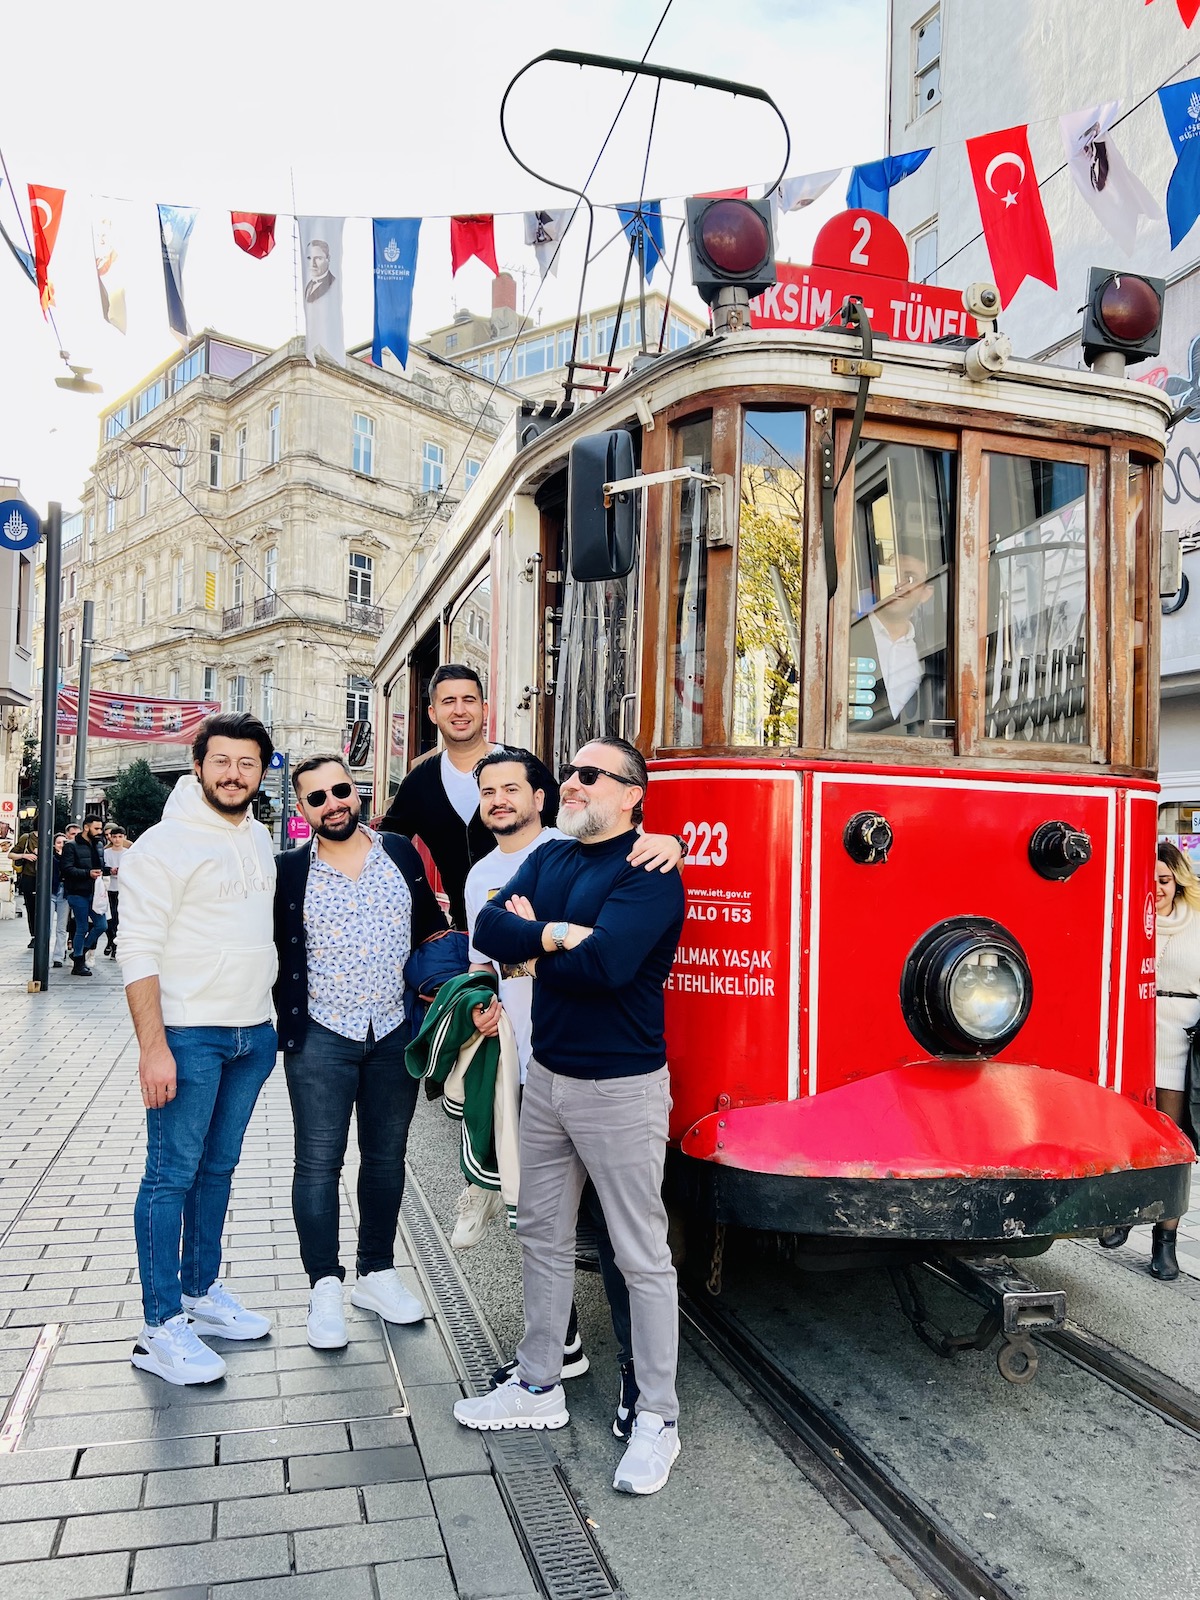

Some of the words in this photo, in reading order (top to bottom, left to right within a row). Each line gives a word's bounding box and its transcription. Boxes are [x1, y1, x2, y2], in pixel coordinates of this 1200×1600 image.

[850, 217, 871, 266] 2
[749, 275, 832, 325] AKSİM
[683, 821, 728, 866] 223
[687, 888, 752, 899] www.iett.gov.tr
[687, 905, 717, 921] ALO
[722, 907, 752, 923] 153
[673, 946, 720, 967] ILMAK
[722, 949, 772, 969] YASAK
[677, 972, 775, 997] TEHLİKELİDİR
